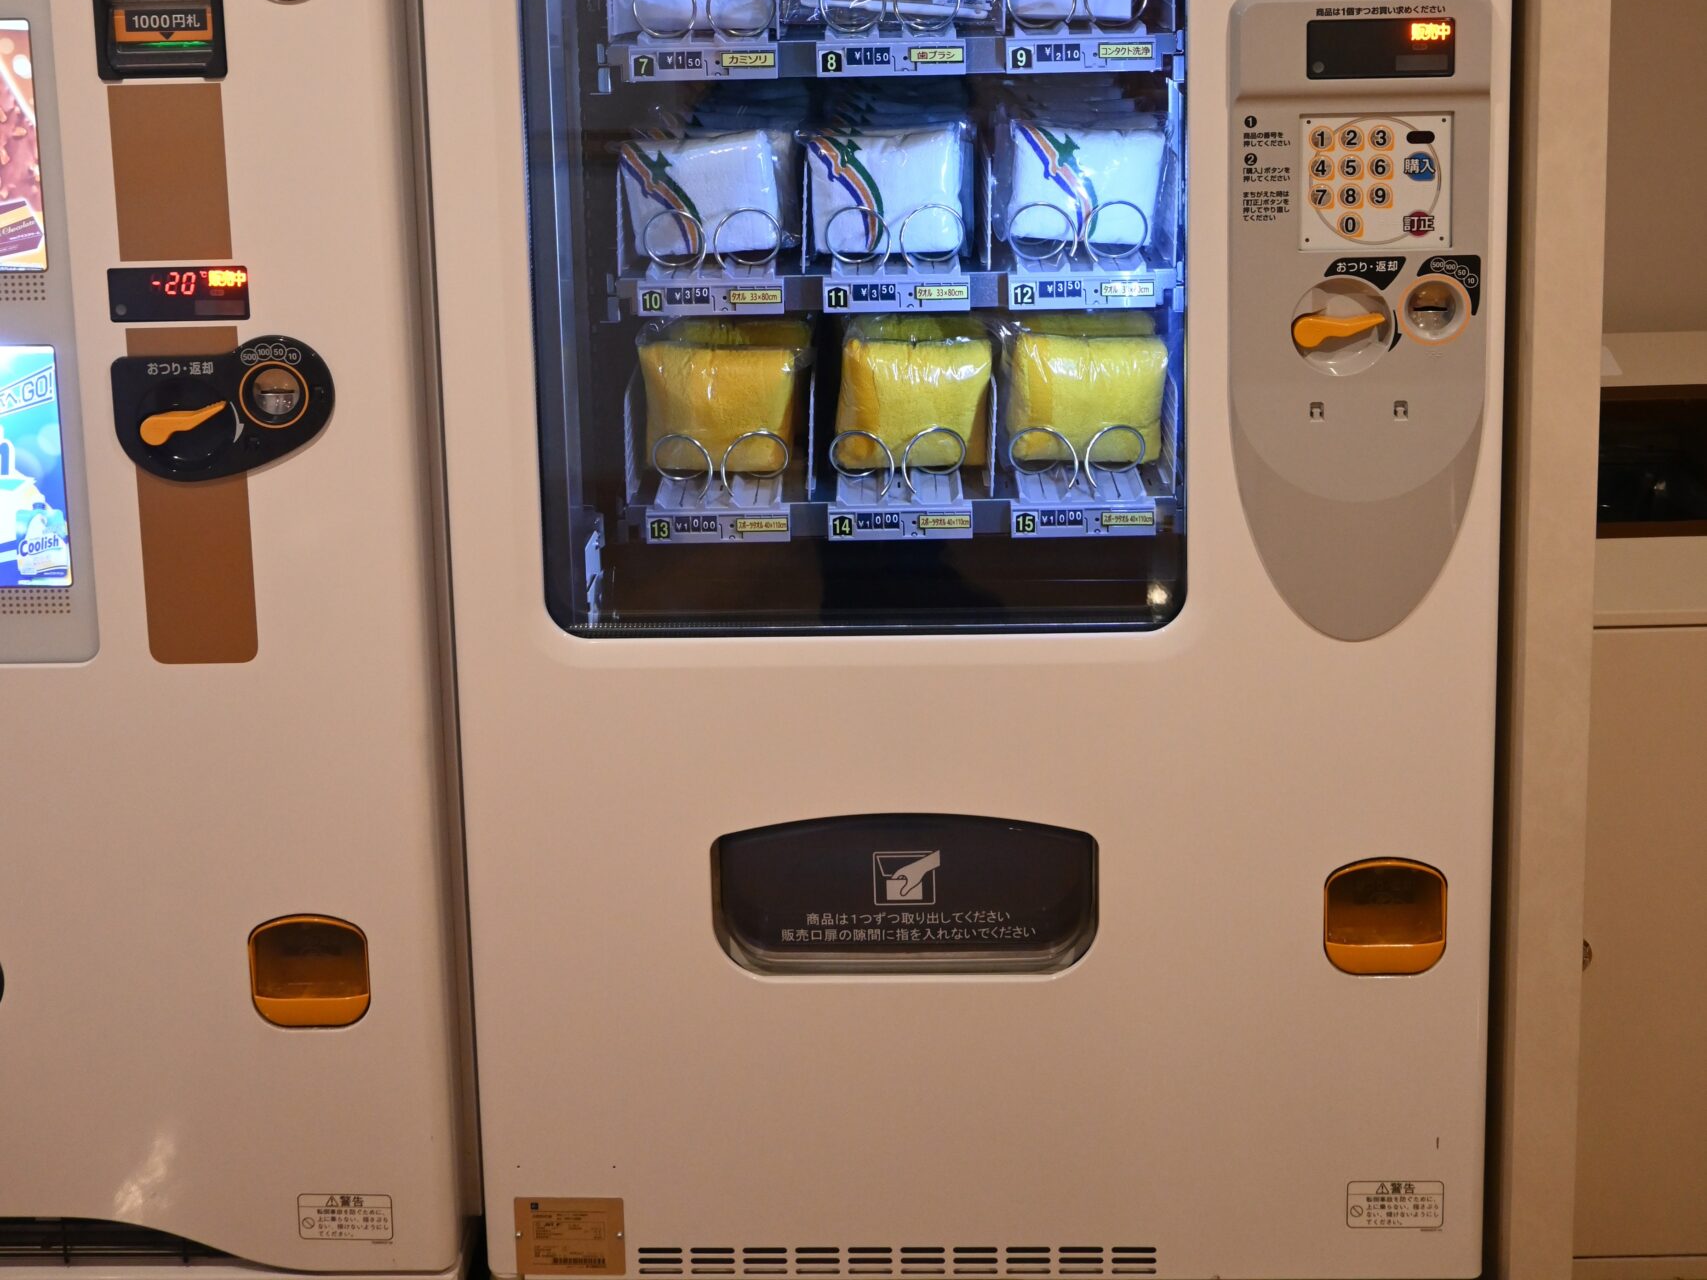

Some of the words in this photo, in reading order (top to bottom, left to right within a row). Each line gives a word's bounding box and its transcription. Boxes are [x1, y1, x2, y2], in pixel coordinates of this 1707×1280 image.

[1316, 5, 1446, 17] 商品は1個ずつお買い求めください
[132, 14, 200, 28] 1000円札
[729, 54, 768, 65] カミソリ
[917, 51, 956, 60] 歯ブラシ
[1016, 49, 1026, 66] 9
[1101, 46, 1151, 57] コンタクト洗浄
[638, 58, 648, 74] 7
[827, 54, 836, 71] 8
[1243, 140, 1291, 148] 押してください
[1316, 131, 1326, 146] 1
[1346, 130, 1357, 145] 2
[1376, 130, 1386, 145] 3
[1314, 160, 1327, 176] 4
[1345, 160, 1356, 176] 5
[1375, 159, 1386, 175] 6
[1404, 158, 1435, 174] 購入
[1243, 175, 1290, 183] 押してください
[1315, 189, 1327, 204] 7
[1345, 188, 1357, 204] 8
[1375, 187, 1386, 204] 9
[1243, 214, 1276, 222] てください
[1344, 217, 1356, 233] 0
[1403, 216, 1434, 232] 訂正
[1336, 260, 1398, 272] おつり・返却
[1432, 260, 1444, 269] 500
[1445, 263, 1456, 271] 100
[1457, 269, 1466, 277] 50
[1467, 277, 1475, 285] 10
[152, 271, 196, 296] -20
[643, 294, 660, 310] 10
[828, 291, 845, 306] 11
[1014, 287, 1033, 303] 12
[242, 353, 257, 361] 500
[257, 348, 270, 356] 100
[273, 348, 284, 356] 50
[288, 352, 297, 360] 10
[147, 361, 214, 376] おつり・返却
[651, 522, 669, 538] 13
[833, 519, 851, 534] 14
[1016, 516, 1034, 531] 15
[20, 534, 60, 557] Coolish
[806, 910, 1010, 926] 商品は1つずつ取り出してください
[781, 926, 1037, 942] 販売口扉の隙間に指を入れないでください
